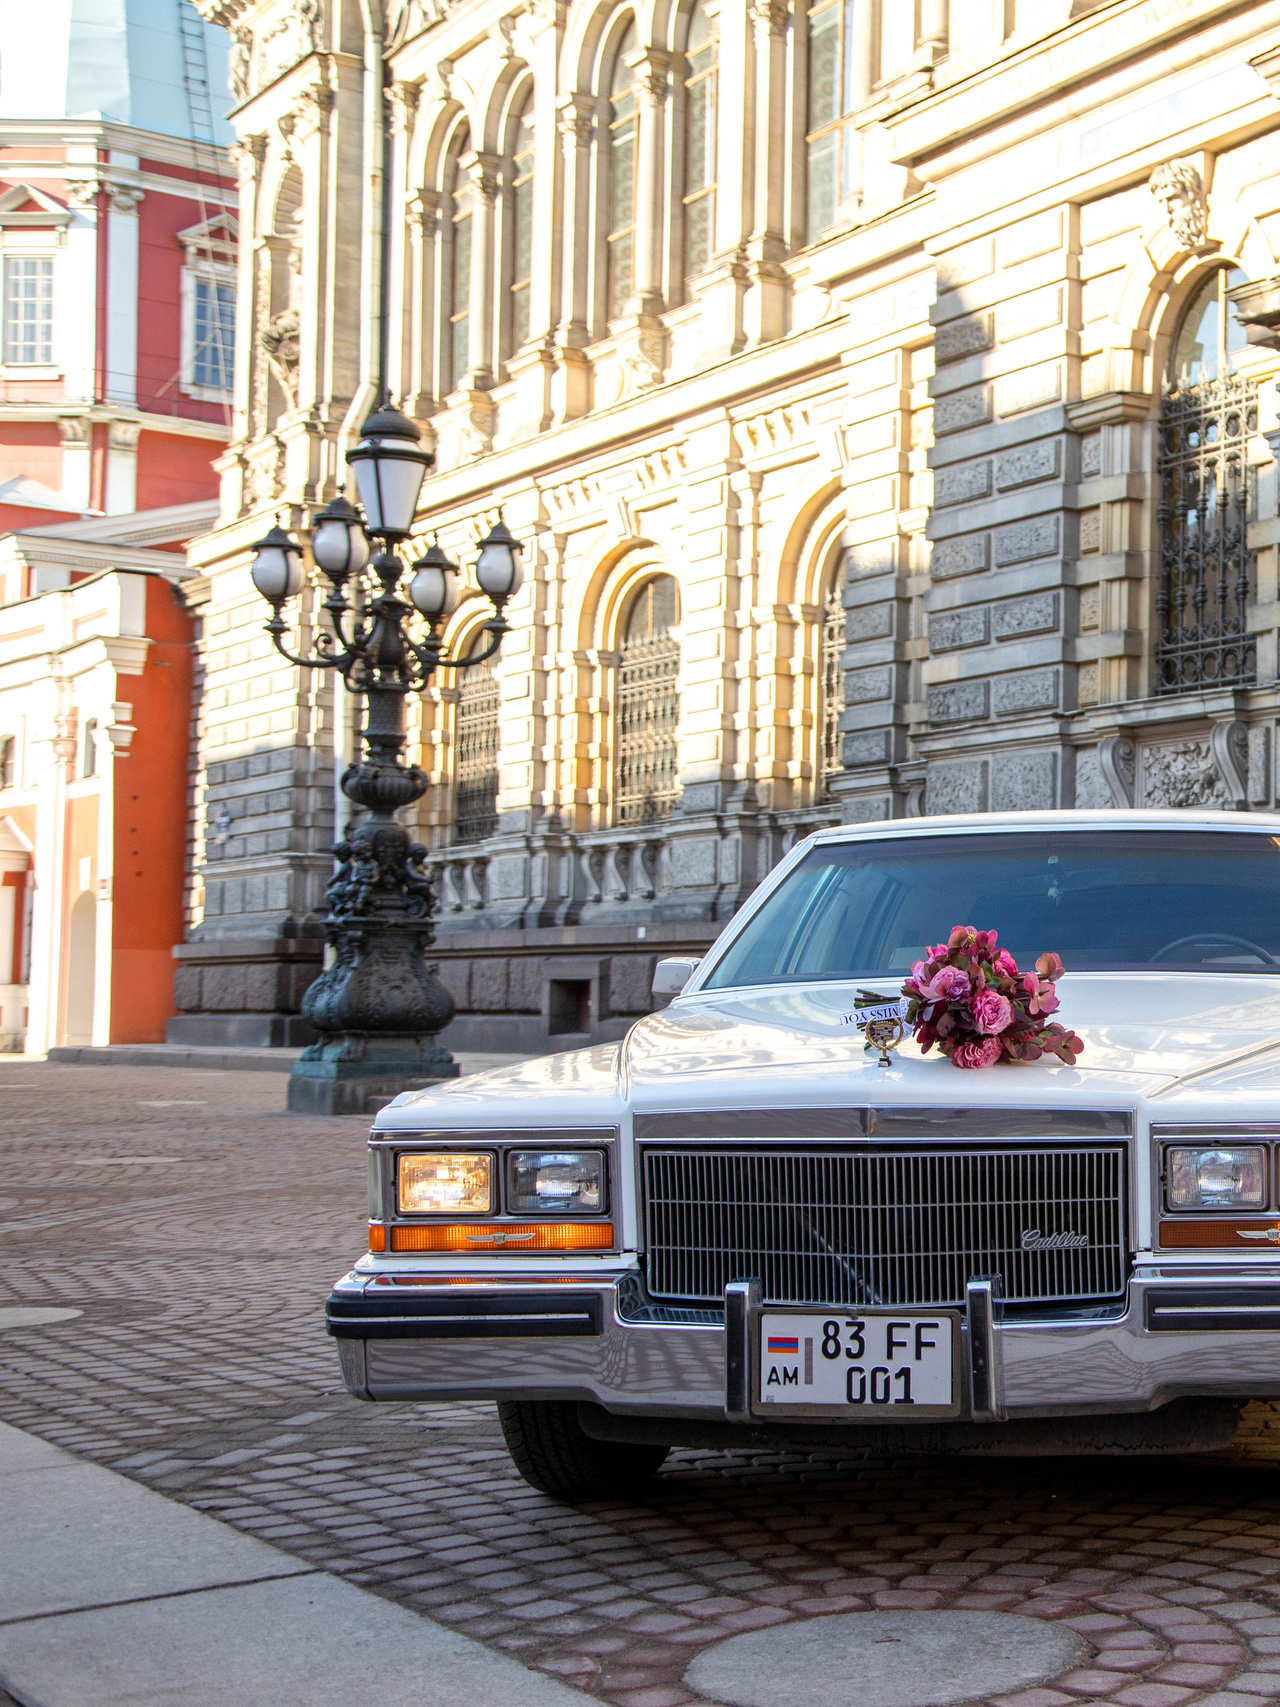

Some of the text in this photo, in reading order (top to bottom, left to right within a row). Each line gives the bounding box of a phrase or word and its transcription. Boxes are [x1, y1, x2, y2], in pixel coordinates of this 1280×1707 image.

[840, 1011, 868, 1026] YOU
[869, 1006, 900, 1019] MISS
[1021, 1229, 1089, 1250] Cadillac
[821, 1319, 940, 1361] 83 FF
[766, 1365, 799, 1386] AM
[846, 1365, 915, 1405] 001
